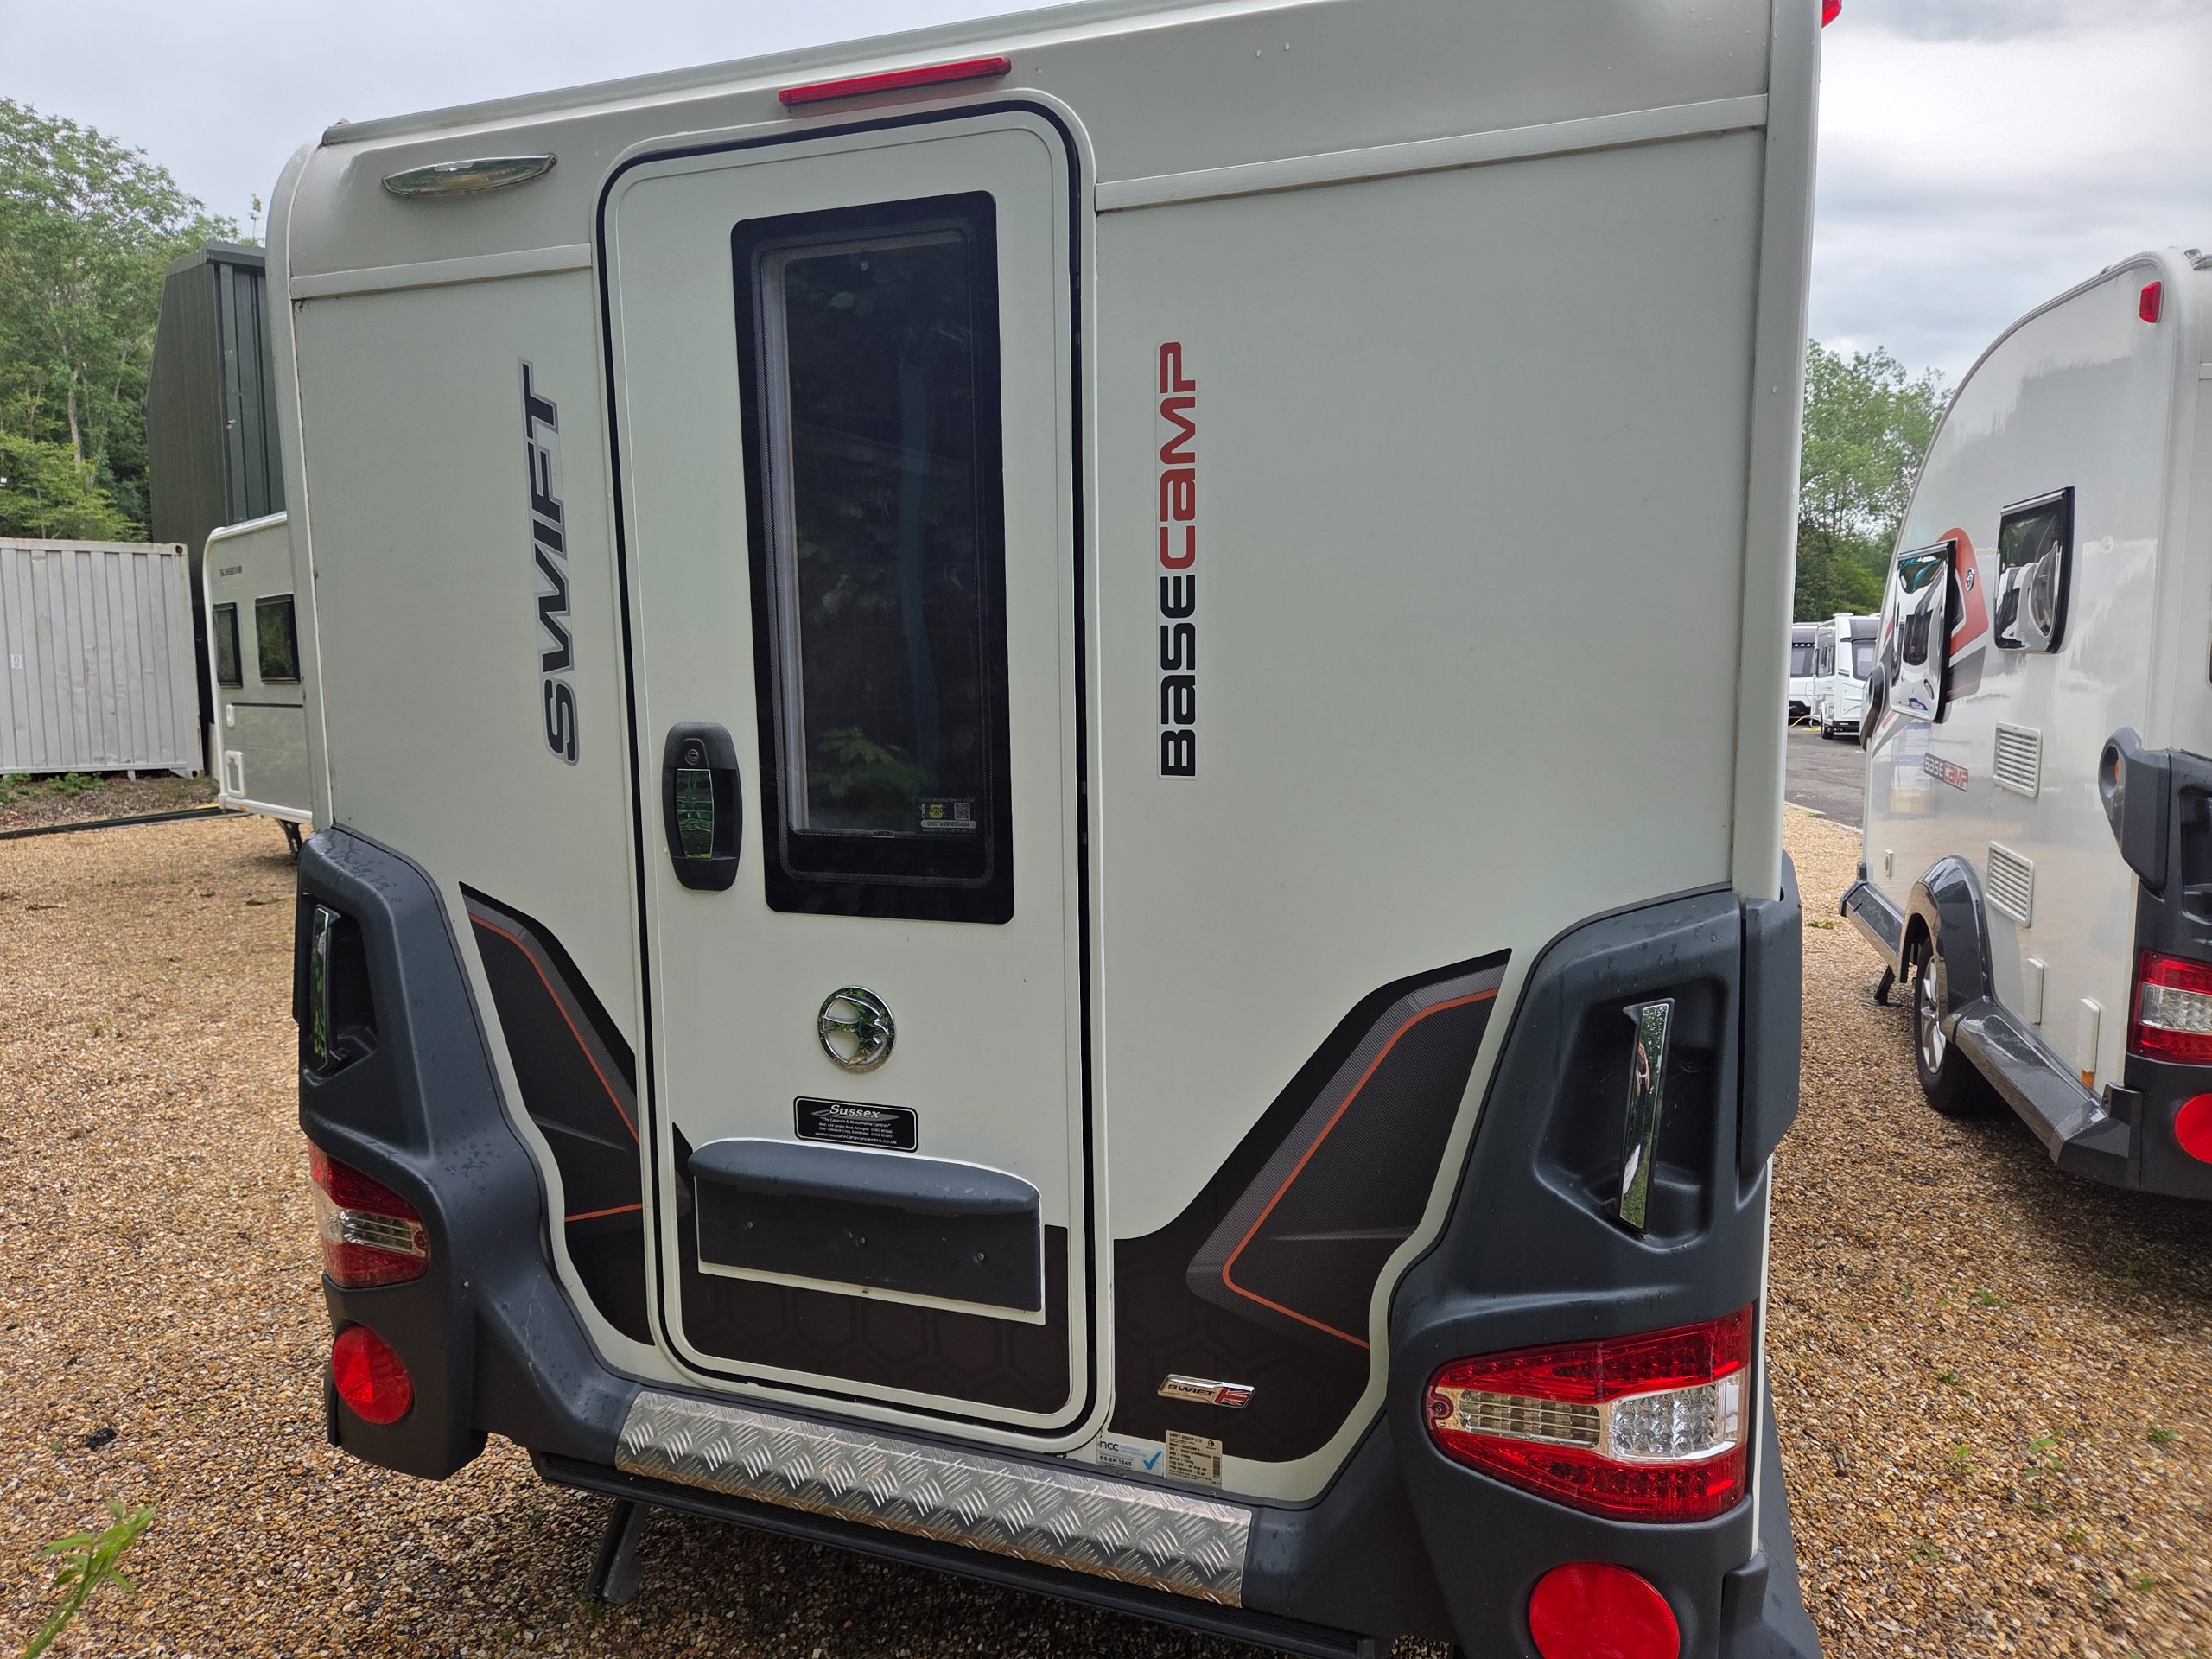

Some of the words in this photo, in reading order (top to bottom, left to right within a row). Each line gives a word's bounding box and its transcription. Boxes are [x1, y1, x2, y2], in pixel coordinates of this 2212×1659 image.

[519, 357, 579, 766] SWIFT
[830, 1104, 880, 1118] Sussex
[815, 1132, 897, 1144] www.sussexcaravancentre.co.uk
[1167, 1383, 1215, 1396] SWIFT
[1100, 1440, 1119, 1456] ncc
